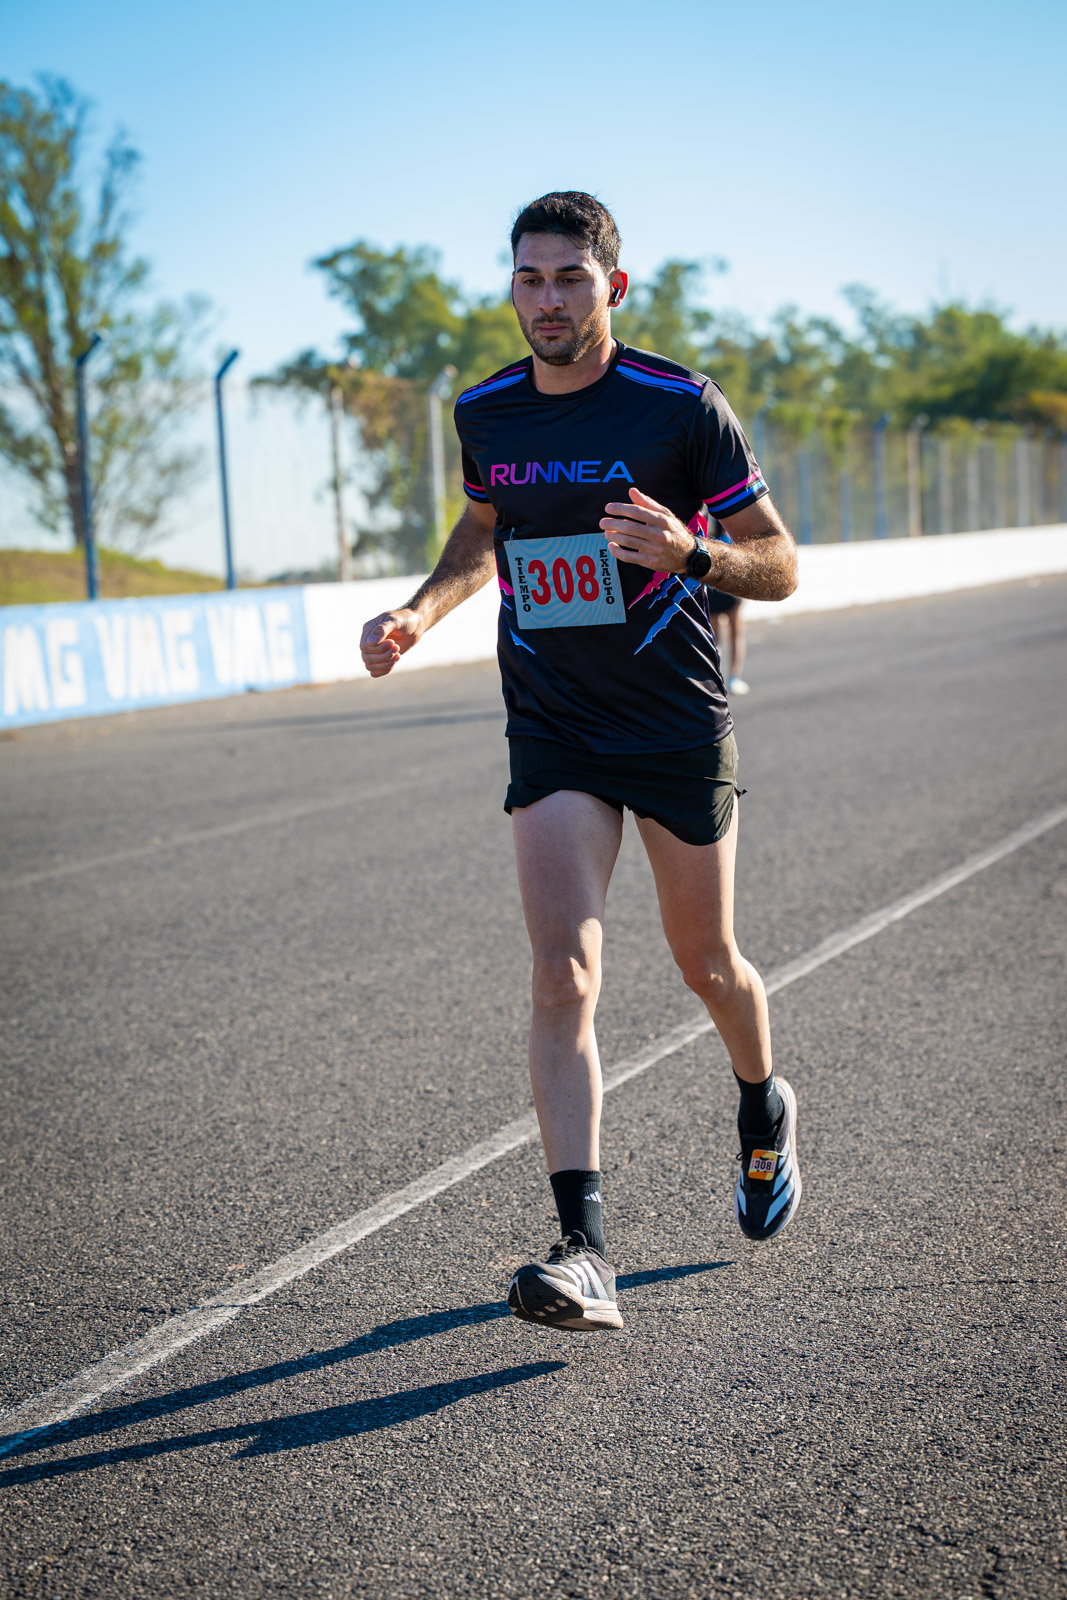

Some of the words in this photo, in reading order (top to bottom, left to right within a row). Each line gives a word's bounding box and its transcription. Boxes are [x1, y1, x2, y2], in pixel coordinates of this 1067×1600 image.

[491, 461, 634, 486] RUNNEA
[514, 557, 532, 613] TIEMPO
[527, 555, 600, 605] 308
[599, 549, 615, 605] EXACTO
[94, 608, 200, 700] VMG
[206, 600, 297, 685] VMG
[754, 1160, 772, 1171] 308
